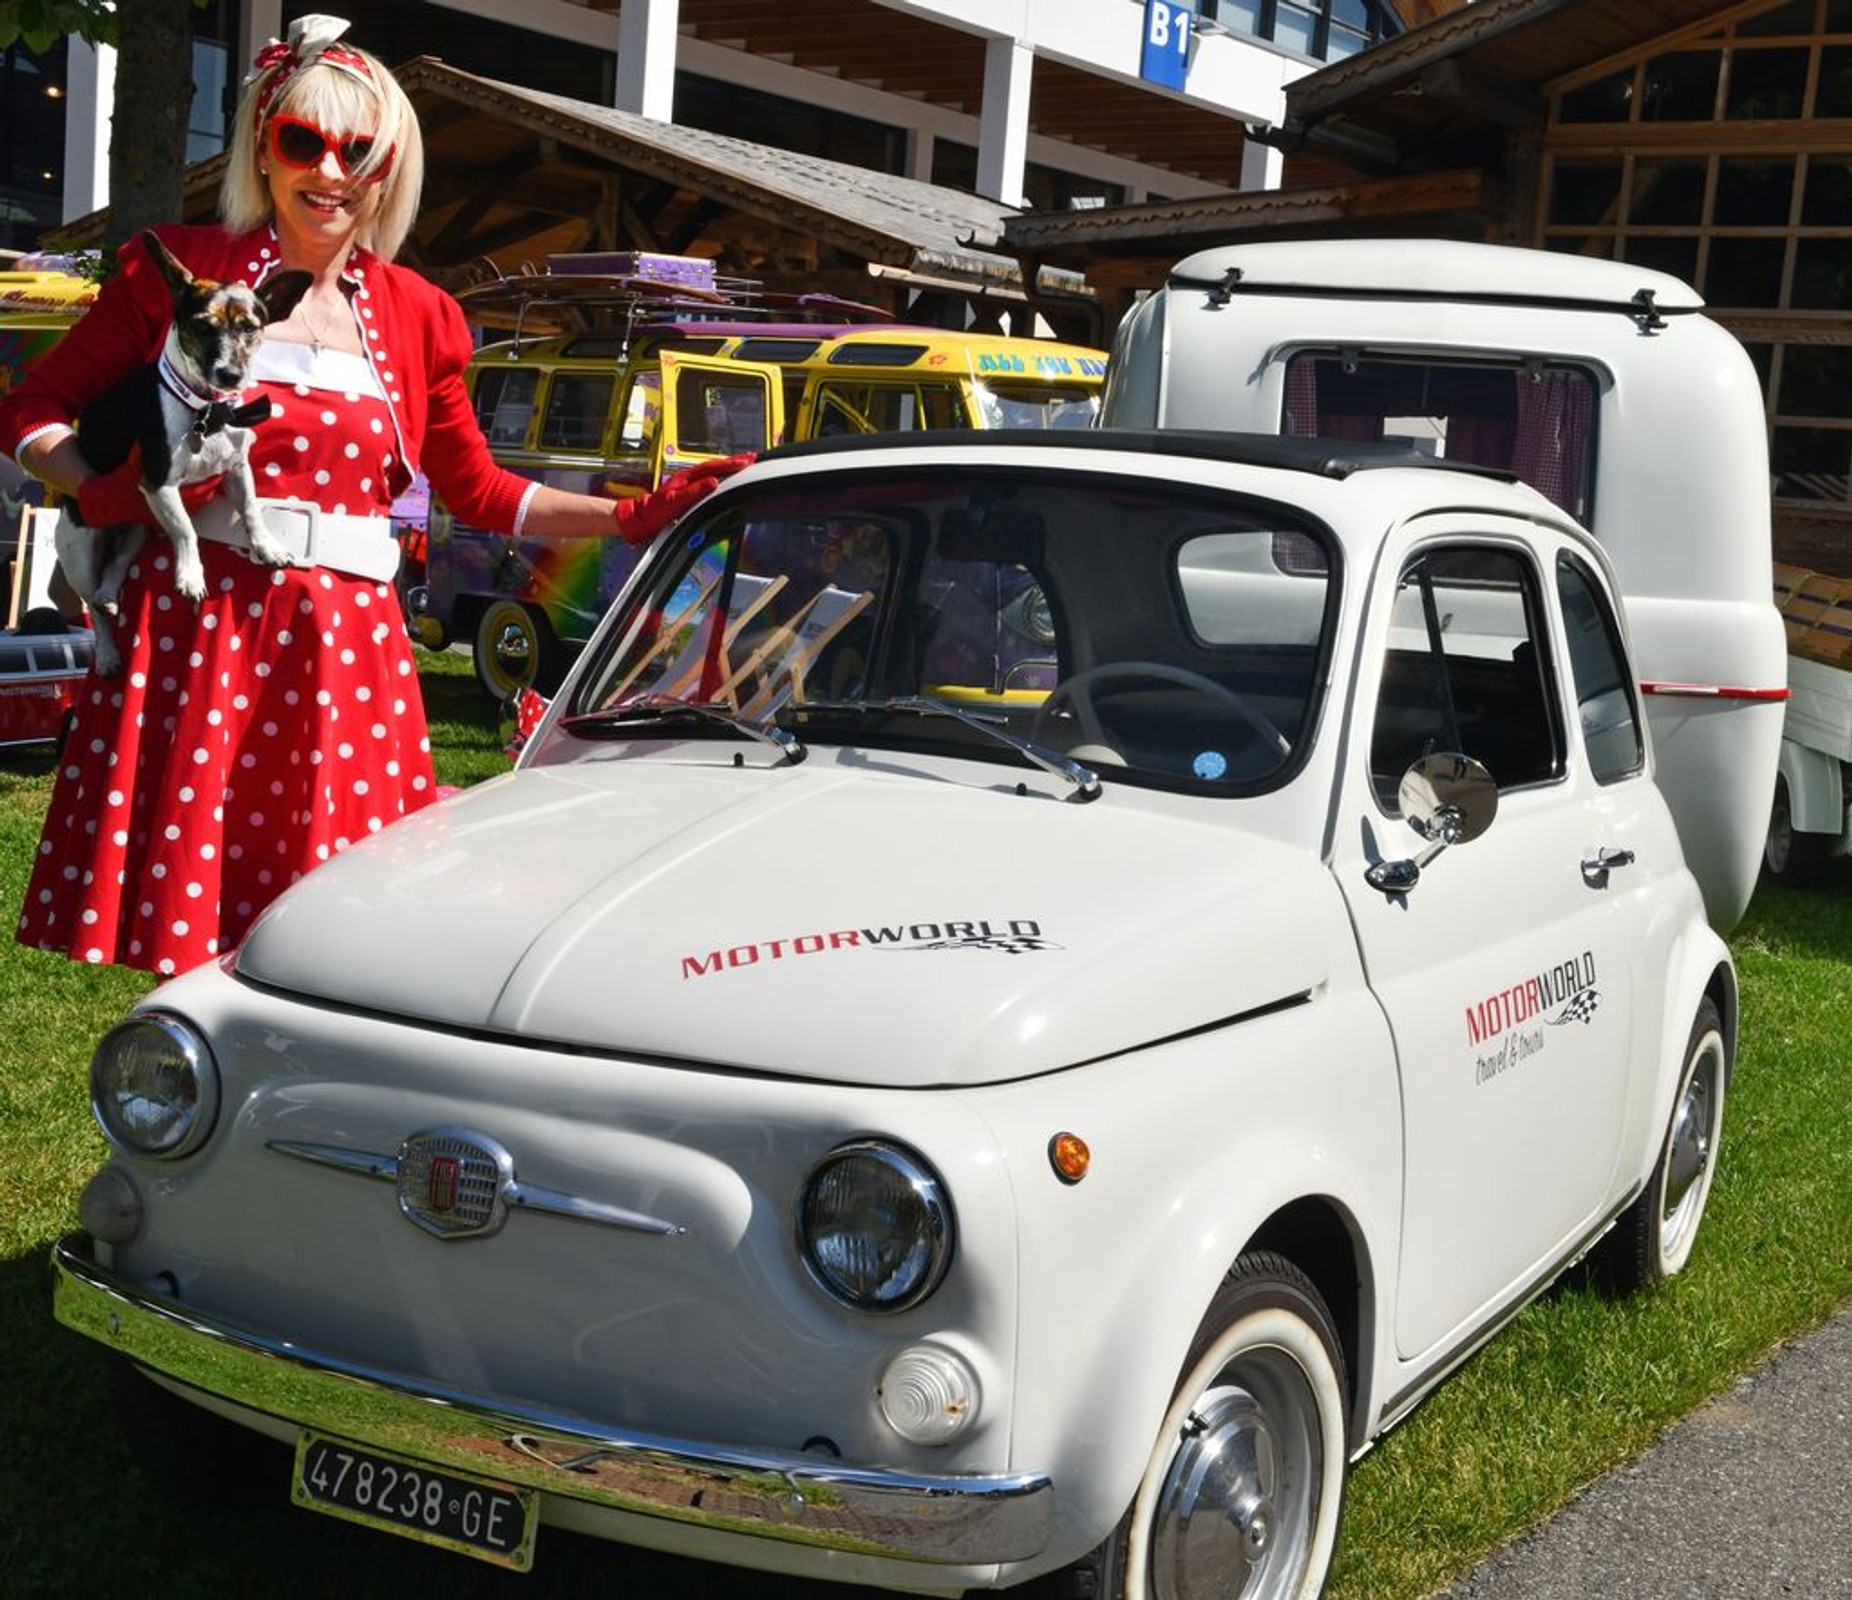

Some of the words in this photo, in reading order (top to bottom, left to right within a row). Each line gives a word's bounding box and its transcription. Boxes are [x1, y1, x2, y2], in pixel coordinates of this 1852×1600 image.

[682, 919, 1041, 980] MOTORWORLD
[1465, 950, 1596, 1047] MOTORWORLD
[311, 1449, 443, 1526] 478238
[462, 1490, 511, 1546] GE
